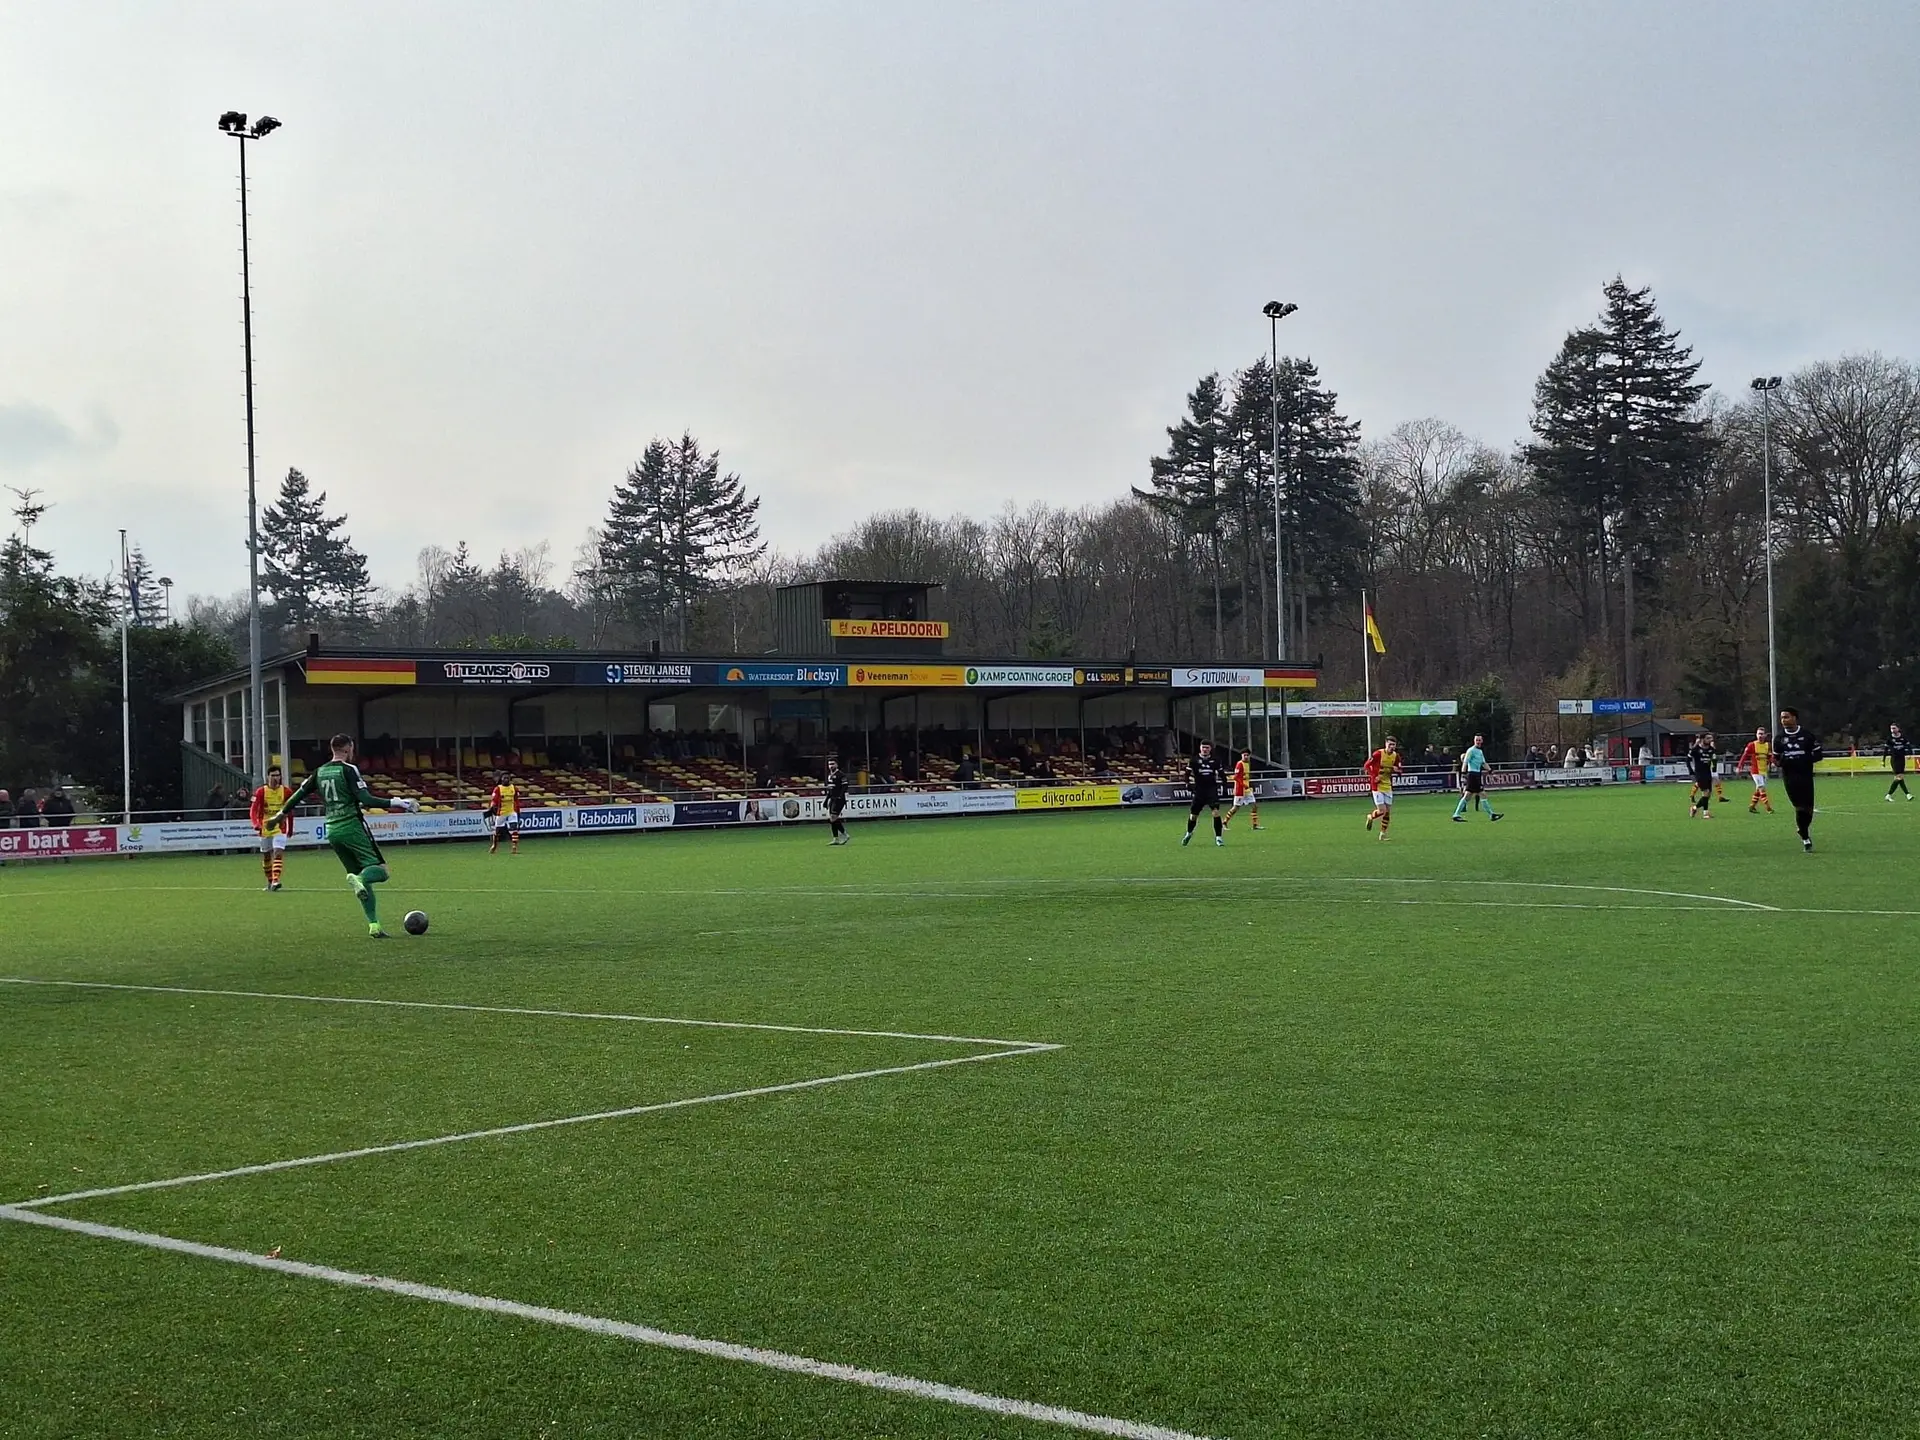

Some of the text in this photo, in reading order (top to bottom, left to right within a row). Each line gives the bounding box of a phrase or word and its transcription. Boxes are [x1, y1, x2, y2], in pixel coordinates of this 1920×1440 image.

[852, 622, 942, 636] csv APELDOORN
[624, 665, 691, 676] STEVEN JANSEN
[868, 672, 908, 681] Veeneman
[980, 672, 1072, 683] KAMP COATING GROEP
[1322, 784, 1370, 793] ZOETBROOD
[1042, 790, 1095, 806] dijkgraaf.nl
[845, 798, 898, 810] TEGEMAN
[580, 810, 635, 826] Rabobank
[28, 830, 69, 849] bart
[120, 844, 144, 853] Scoop
